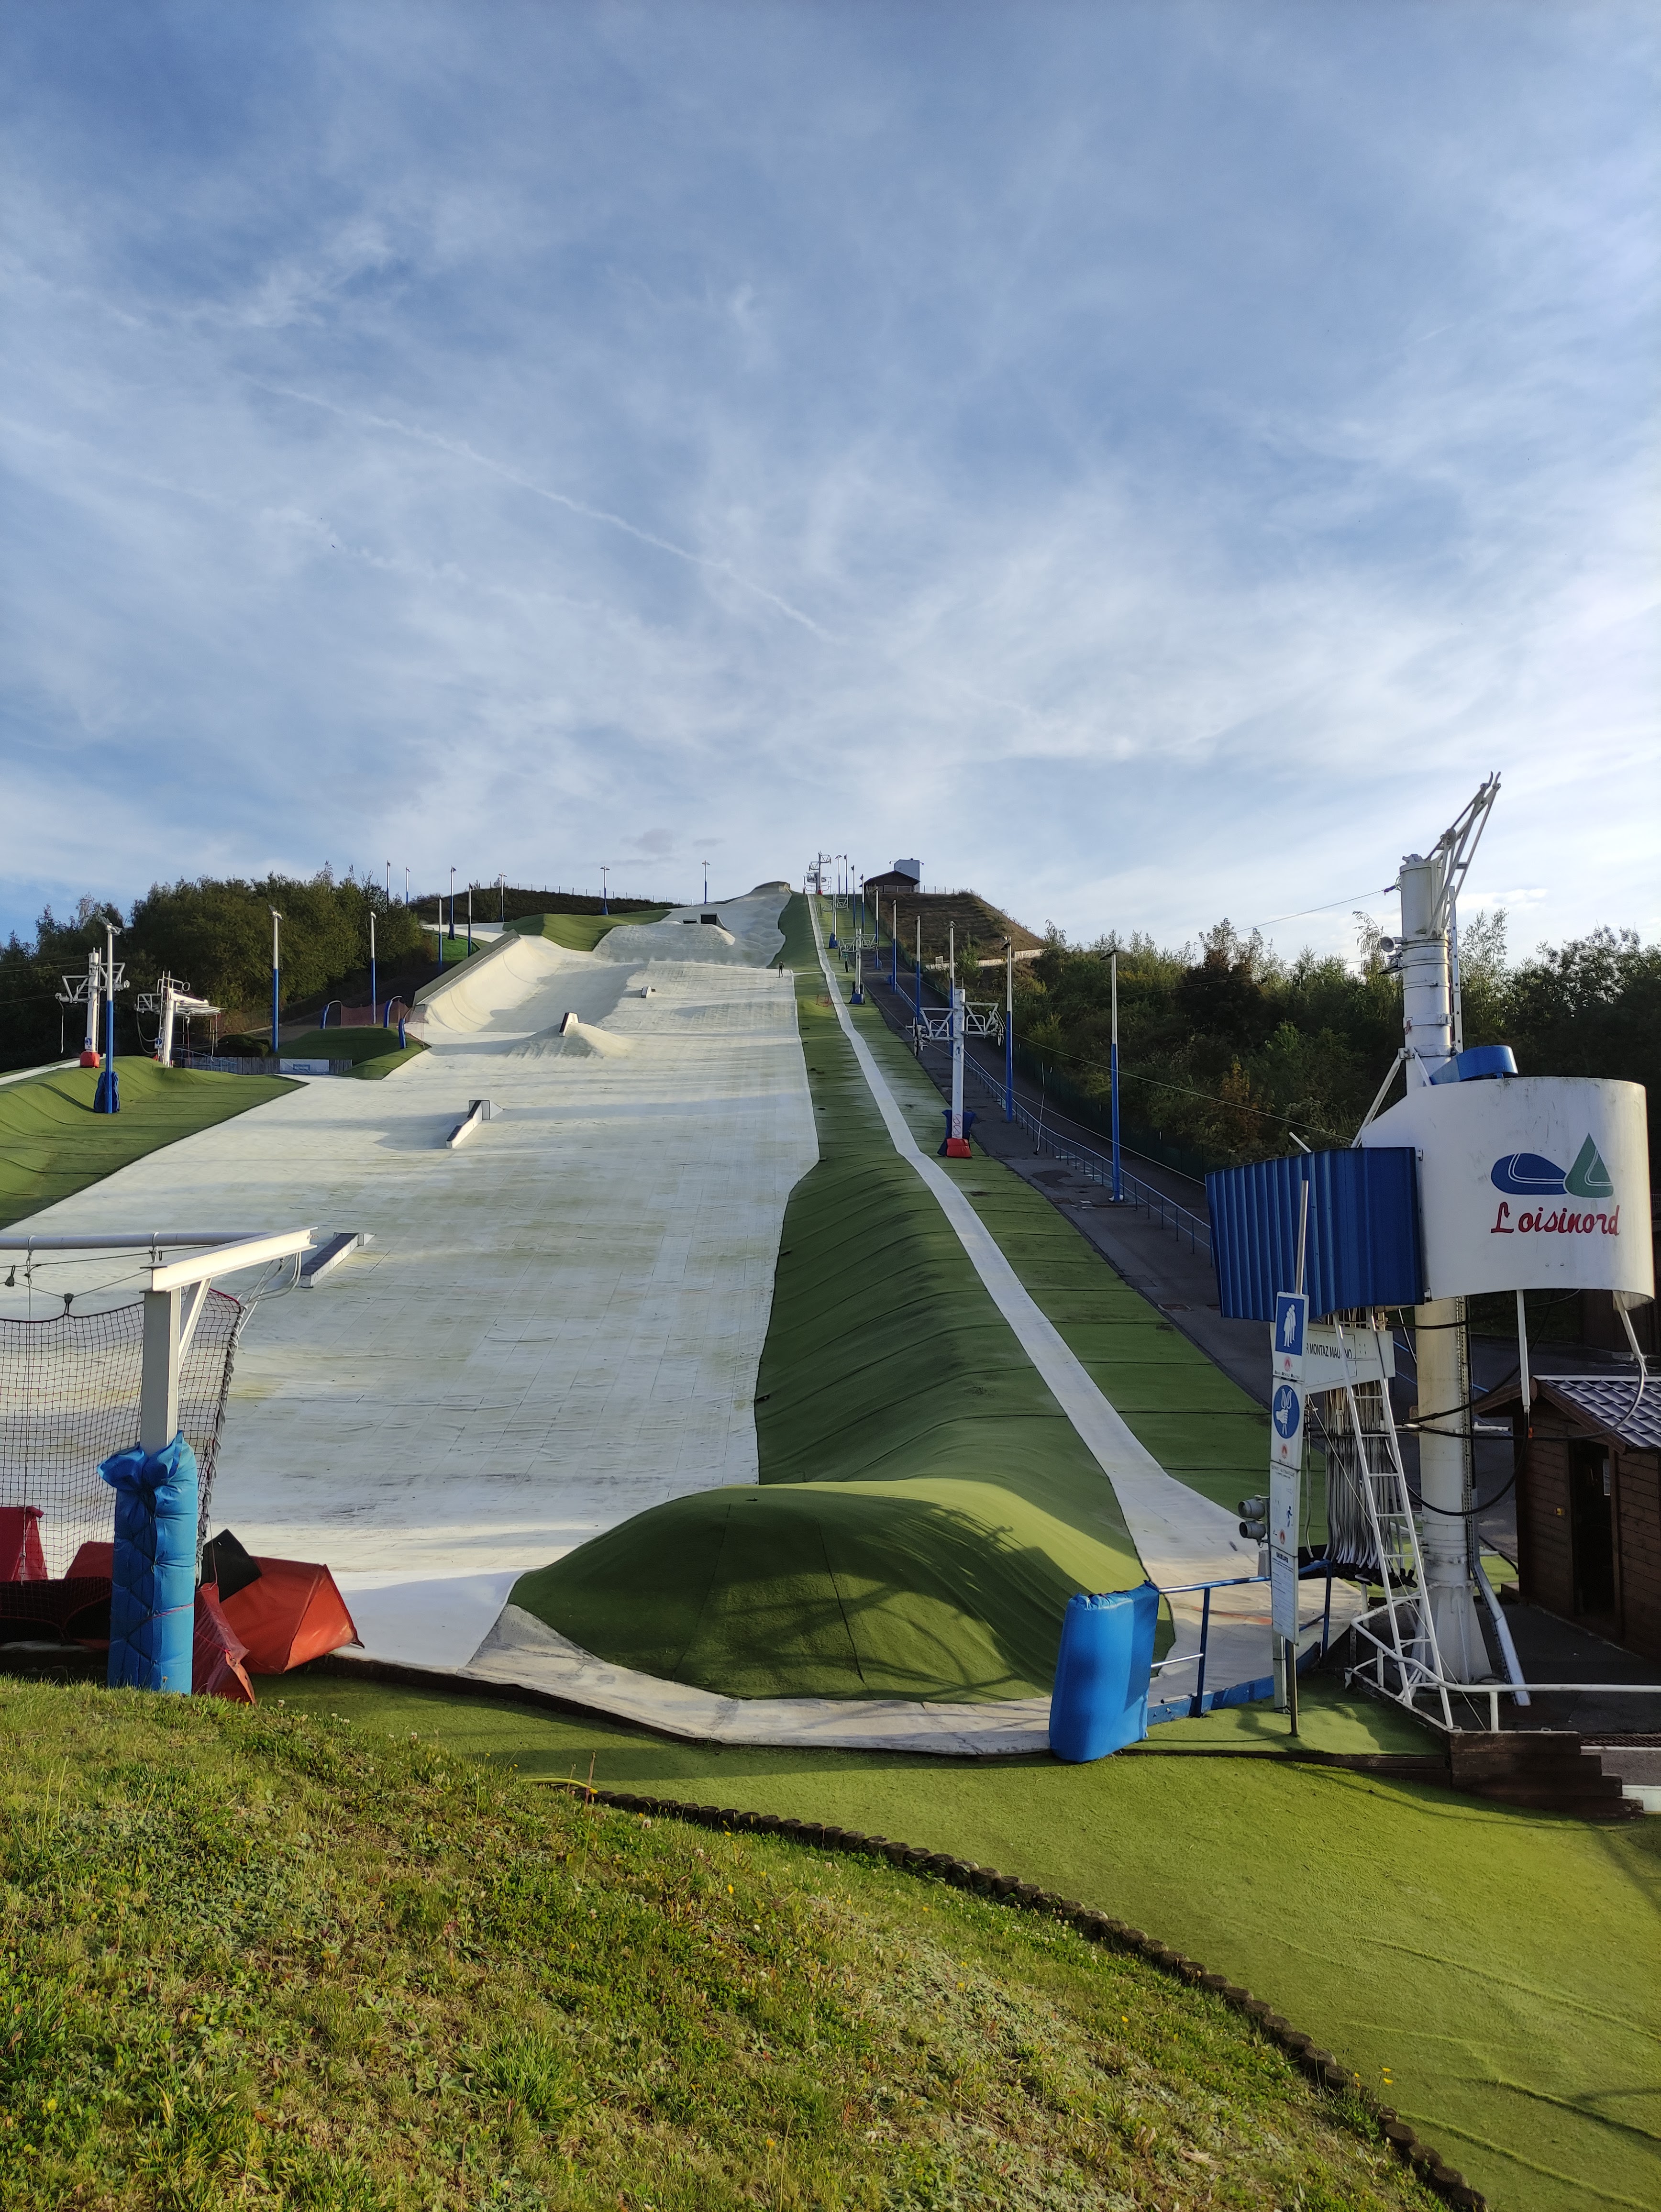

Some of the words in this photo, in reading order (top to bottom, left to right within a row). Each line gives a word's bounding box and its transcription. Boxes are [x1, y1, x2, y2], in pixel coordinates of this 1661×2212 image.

[1490, 1202, 1620, 1236] Loisinord
[1309, 1343, 1329, 1357] MONTAZ
[1329, 1346, 1352, 1359] MAUNO
